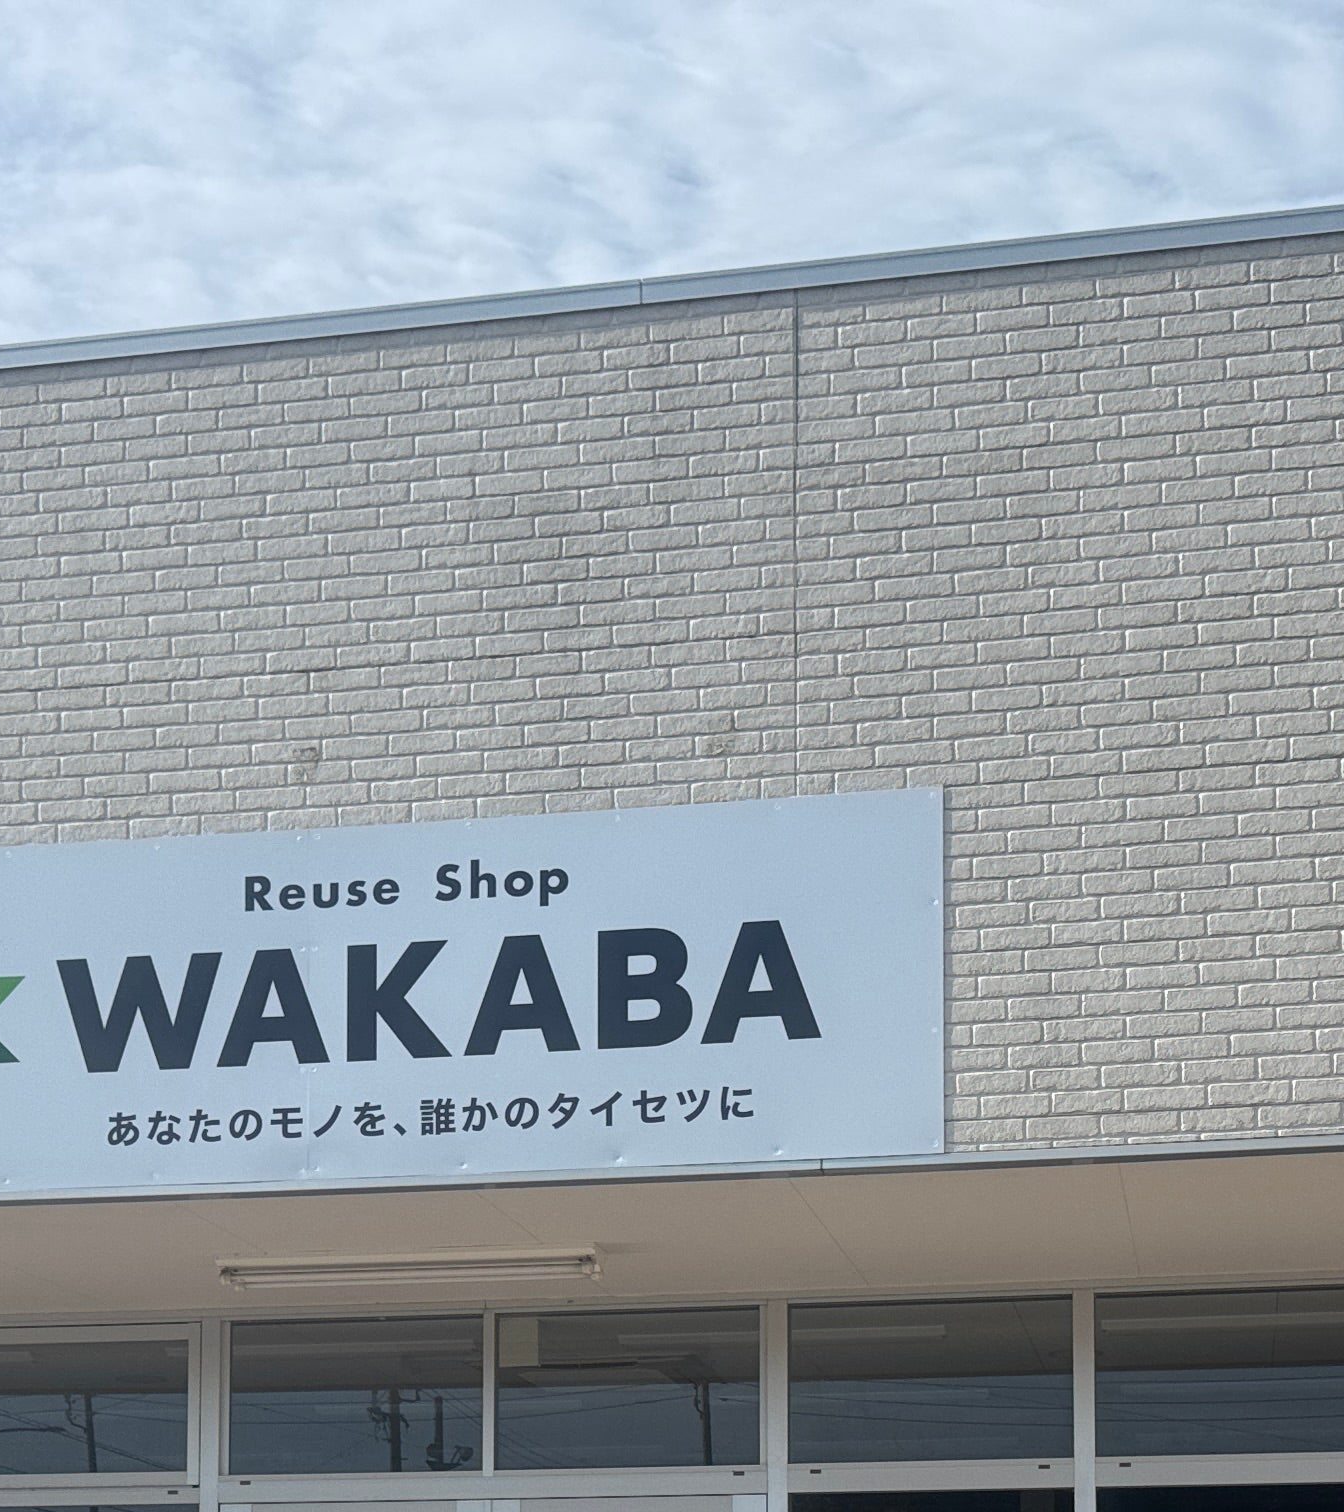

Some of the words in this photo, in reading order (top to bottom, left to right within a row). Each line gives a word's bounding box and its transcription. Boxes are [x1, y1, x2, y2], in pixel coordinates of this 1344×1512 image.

[244, 873, 401, 913] Reuse
[434, 860, 571, 909] Shop
[57, 919, 823, 1074] WAKABA
[107, 1085, 755, 1147] あなたのモノを、誰かのタイセツに
